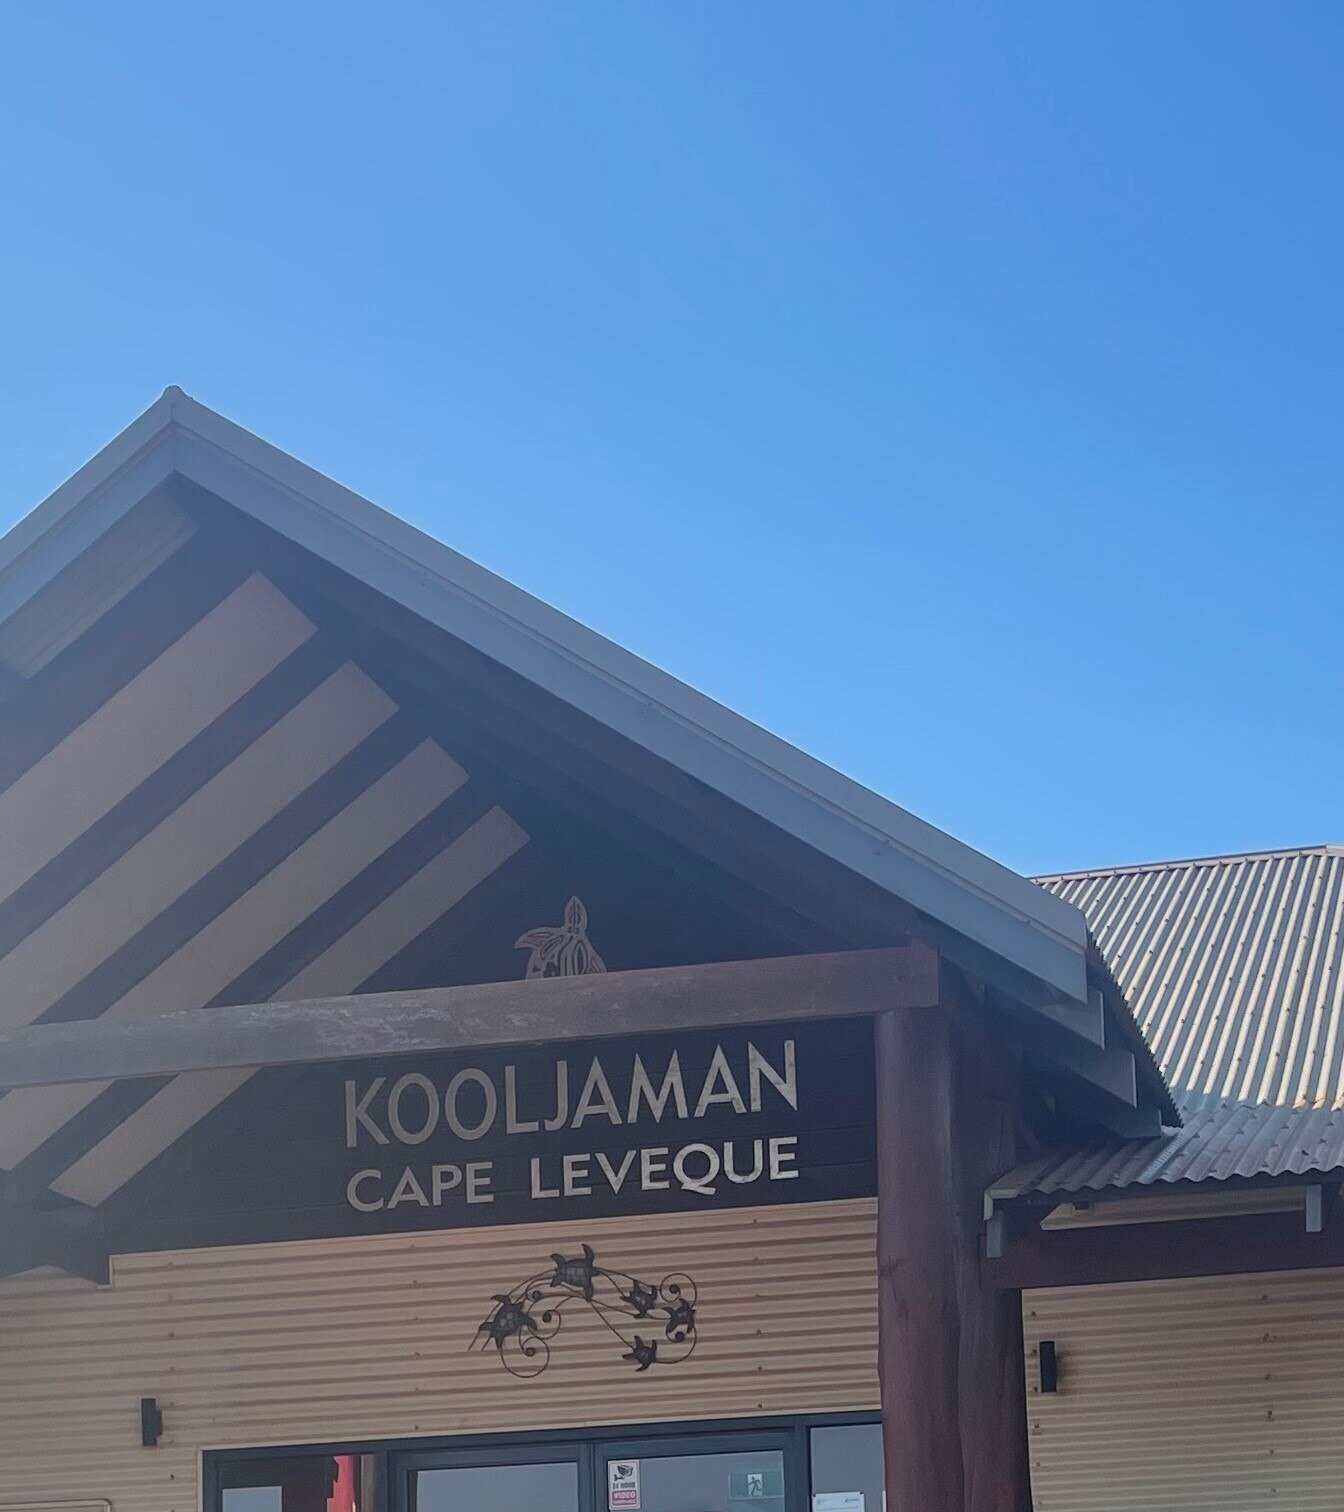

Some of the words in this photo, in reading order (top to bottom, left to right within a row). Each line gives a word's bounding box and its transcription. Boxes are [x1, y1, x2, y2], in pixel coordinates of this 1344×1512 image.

[345, 1040, 798, 1148] KOOLJAMAN
[346, 1162, 494, 1213] CAPE
[531, 1136, 800, 1199] LEVEQUE
